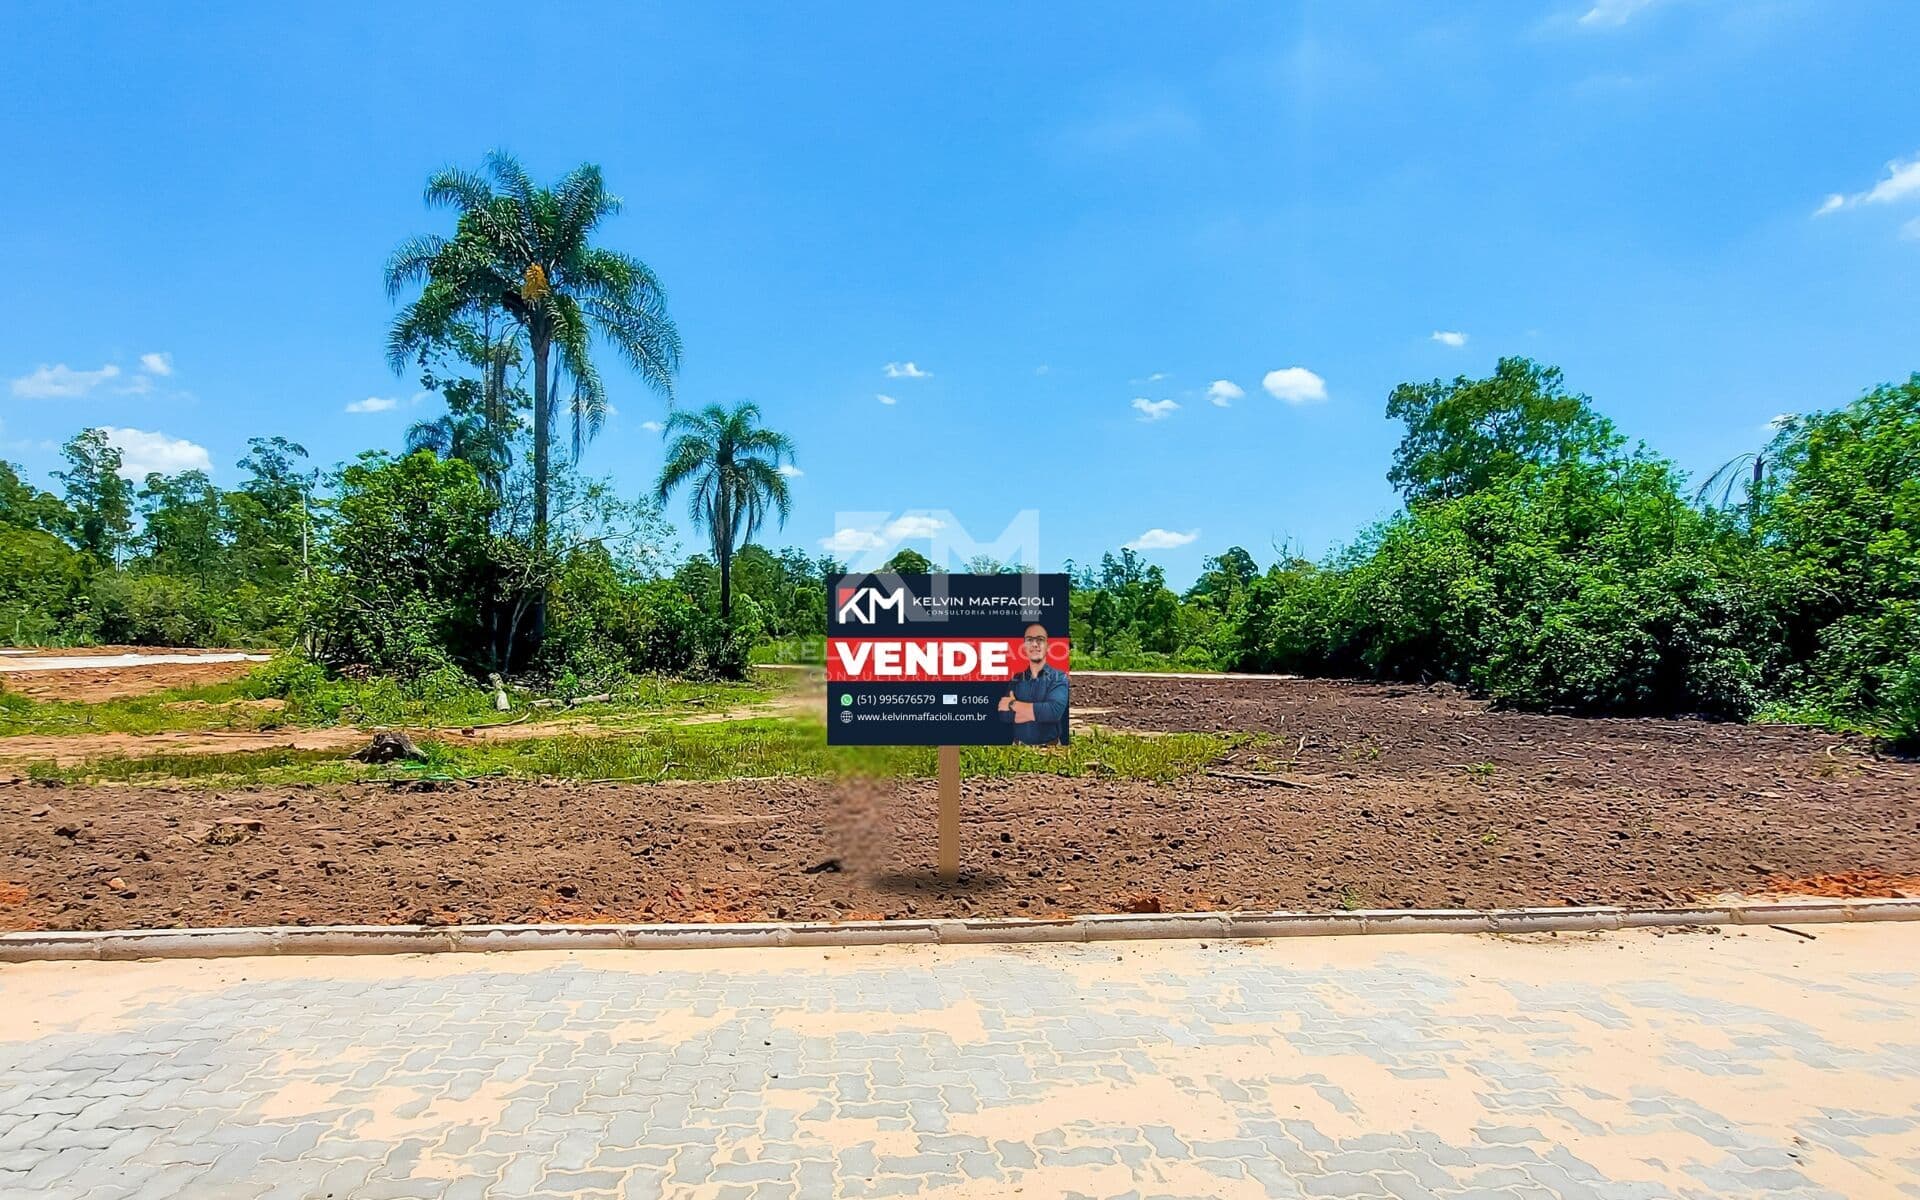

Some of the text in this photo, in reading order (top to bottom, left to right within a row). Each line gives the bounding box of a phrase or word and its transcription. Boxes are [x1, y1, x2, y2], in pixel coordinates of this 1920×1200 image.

[838, 587, 905, 625] KM
[912, 596, 1055, 607] KELVIN MAFFACIOLI
[834, 641, 1009, 676] VENDE
[857, 694, 936, 706] (51) 995676579
[961, 695, 989, 704] 61066
[857, 711, 988, 721] www.kelvinmaffacioli.com.br
